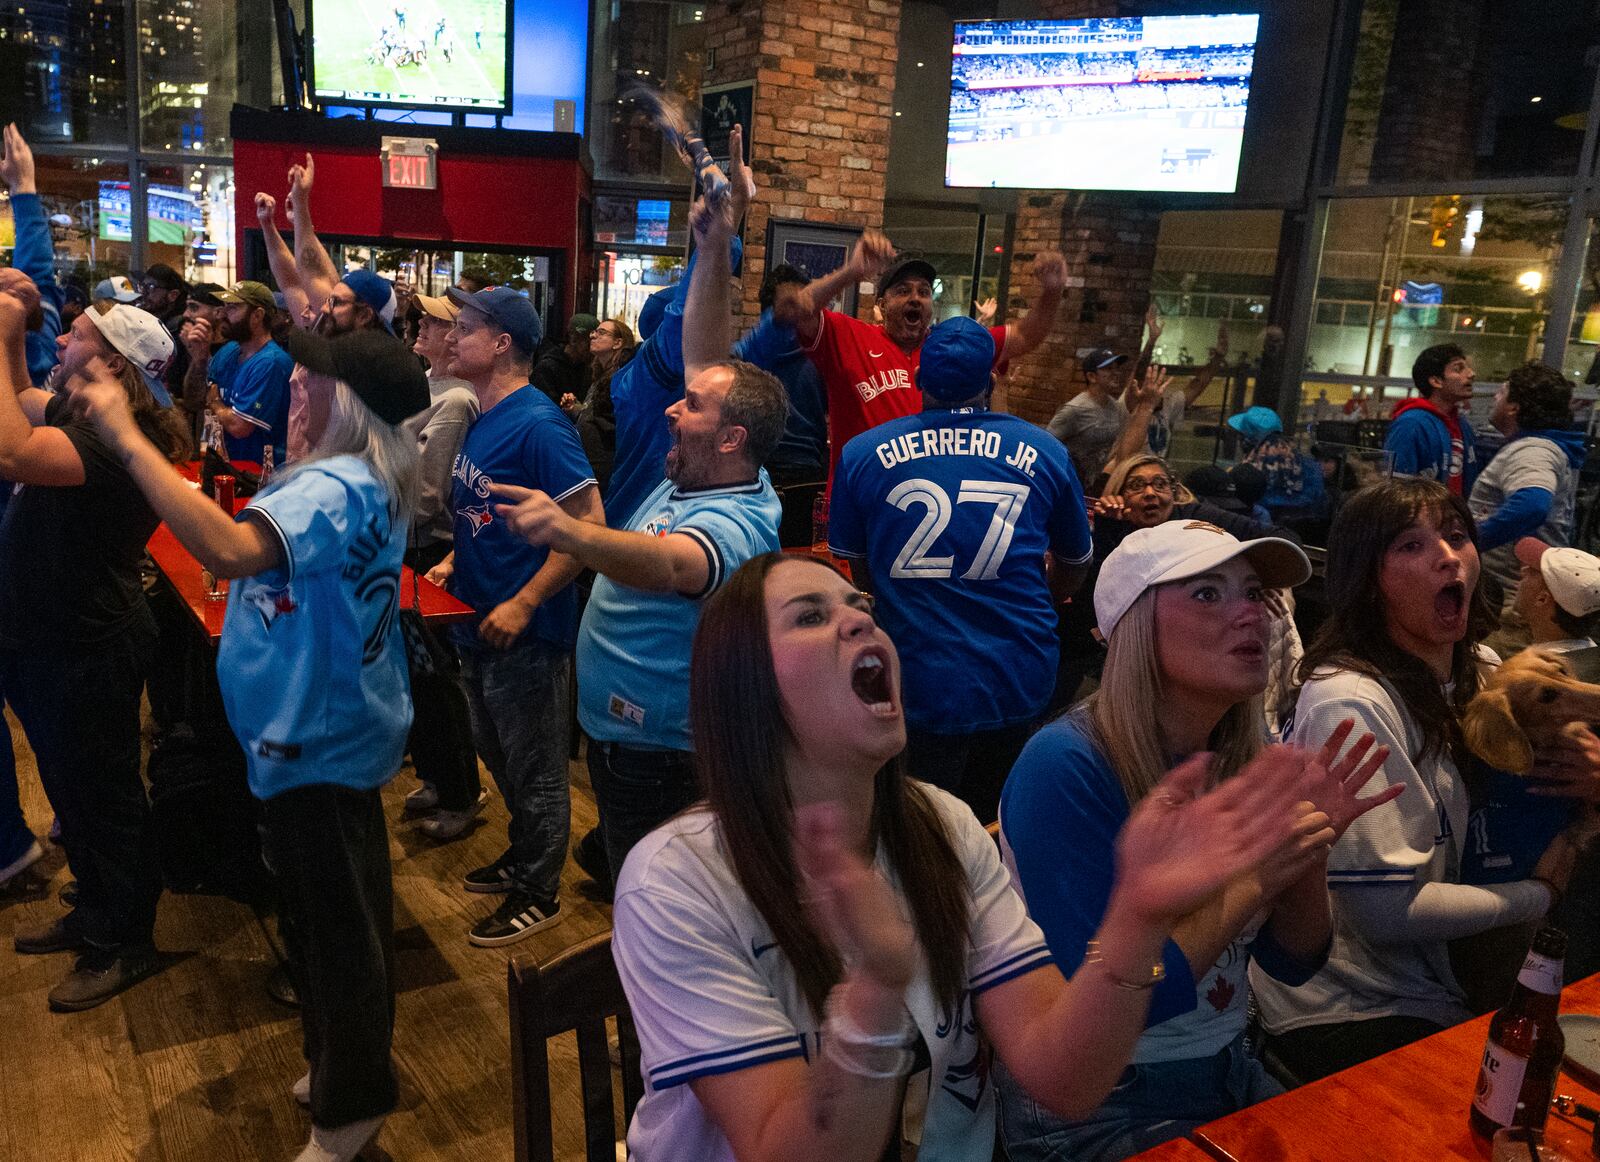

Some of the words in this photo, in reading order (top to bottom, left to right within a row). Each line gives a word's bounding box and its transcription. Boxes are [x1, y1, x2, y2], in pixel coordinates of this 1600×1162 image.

[390, 155, 428, 186] EXIT
[855, 369, 911, 403] BLUE
[875, 428, 1002, 470] GUERRERO
[1005, 441, 1038, 478] JR.
[456, 454, 493, 499] JAYS
[885, 478, 1031, 581] 27
[1484, 1049, 1500, 1073] te
